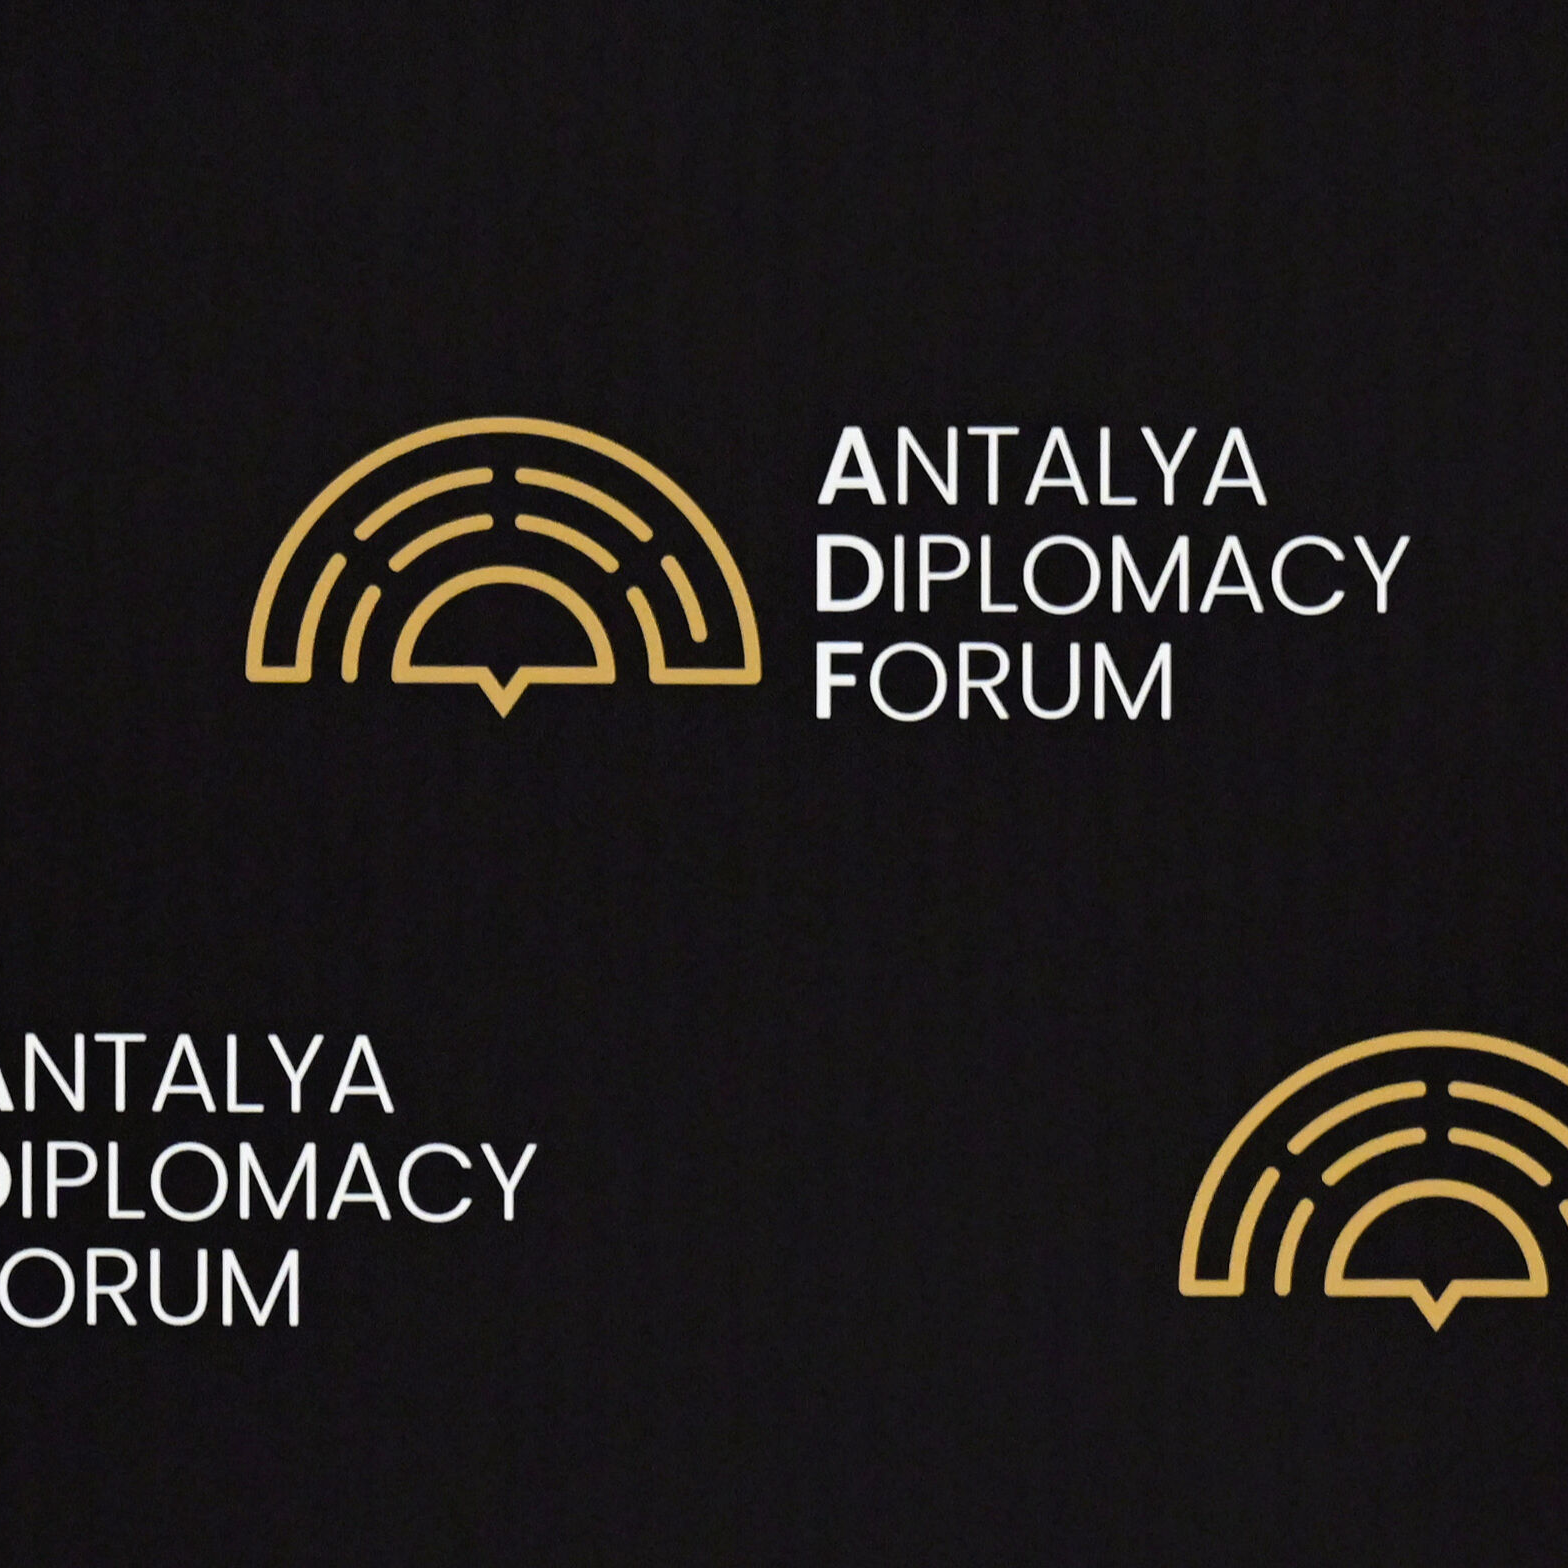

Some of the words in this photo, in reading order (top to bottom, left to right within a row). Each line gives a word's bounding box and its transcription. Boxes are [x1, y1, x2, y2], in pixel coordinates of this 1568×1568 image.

[817, 425, 1268, 506] ANTALYA
[815, 533, 1411, 616] DIPLOMACY
[815, 640, 1172, 722] FORUM
